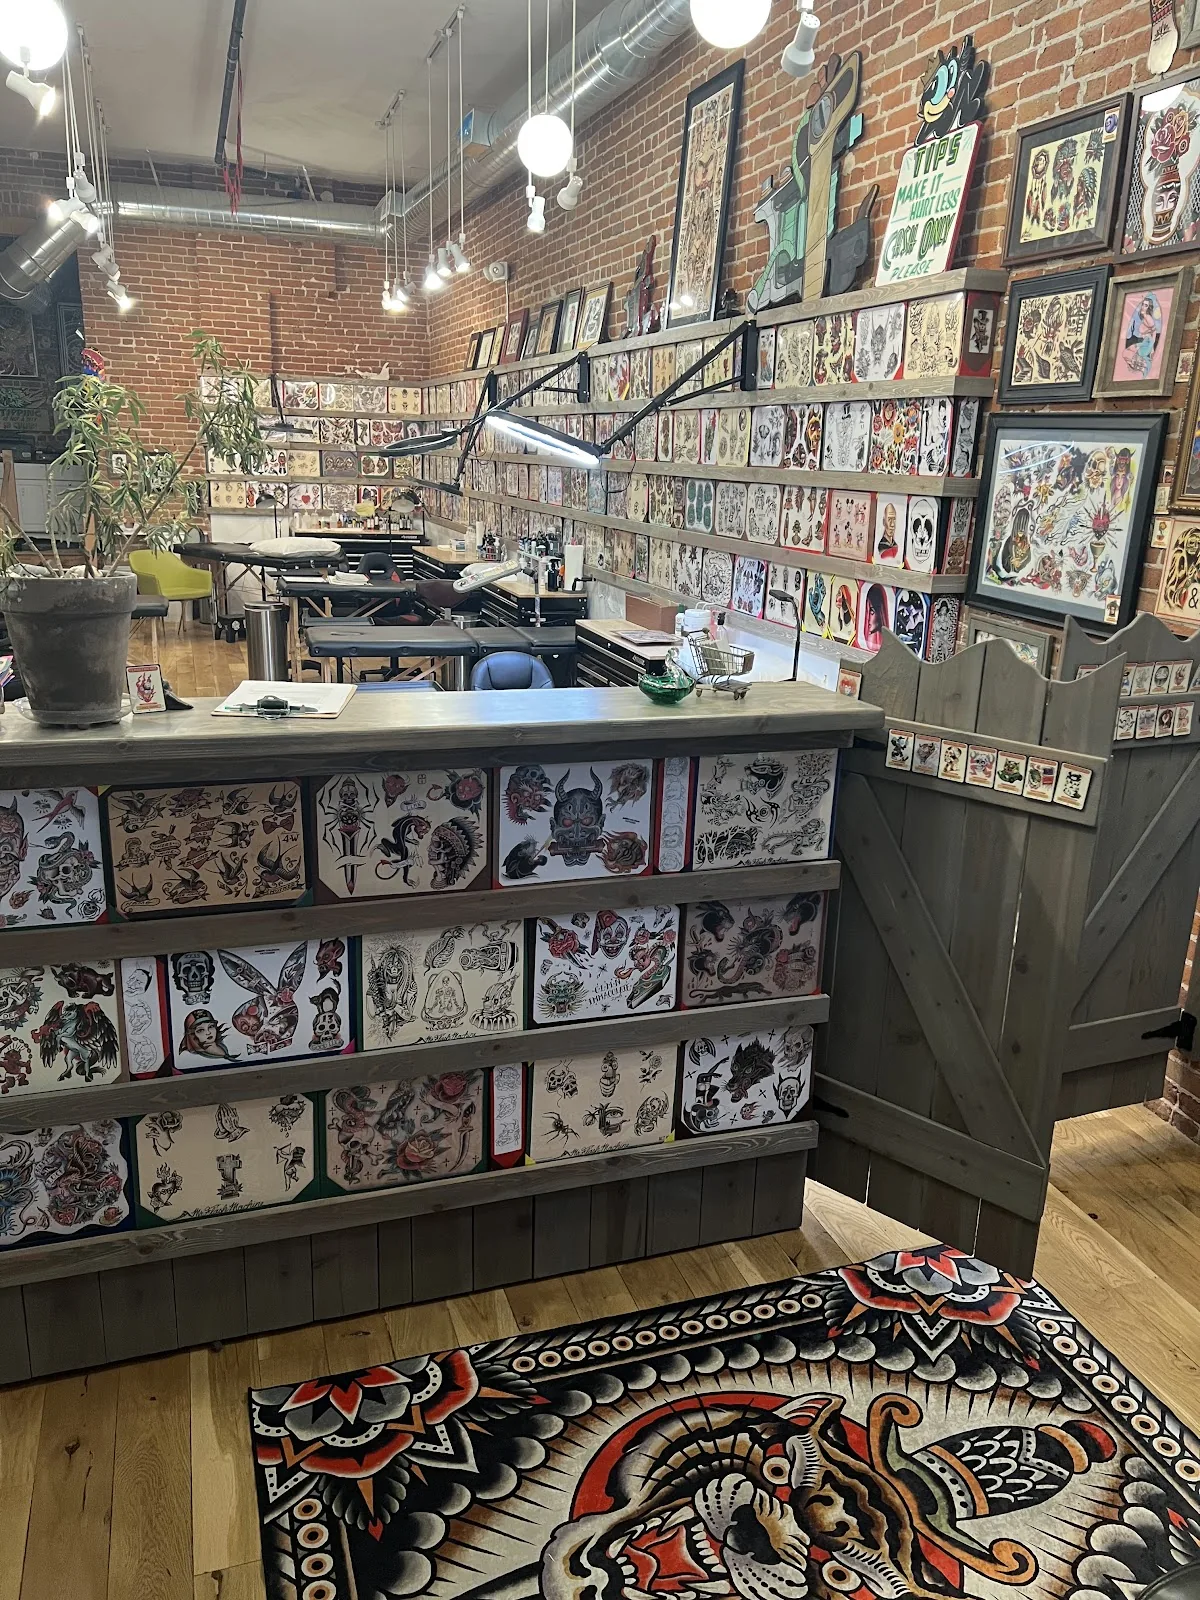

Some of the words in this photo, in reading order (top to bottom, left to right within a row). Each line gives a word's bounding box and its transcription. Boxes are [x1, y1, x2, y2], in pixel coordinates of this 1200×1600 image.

[913, 132, 962, 178] TIPS
[893, 178, 928, 218] MAKE
[930, 173, 944, 194] IT
[909, 198, 936, 222] HURT
[934, 187, 961, 214] LESS
[882, 223, 919, 271] CASH
[917, 212, 956, 261] ONLY
[889, 259, 934, 280] PLEASE
[323, 1015, 333, 1023] 13
[205, 1203, 228, 1215] Flash
[229, 1199, 264, 1212] Machine
